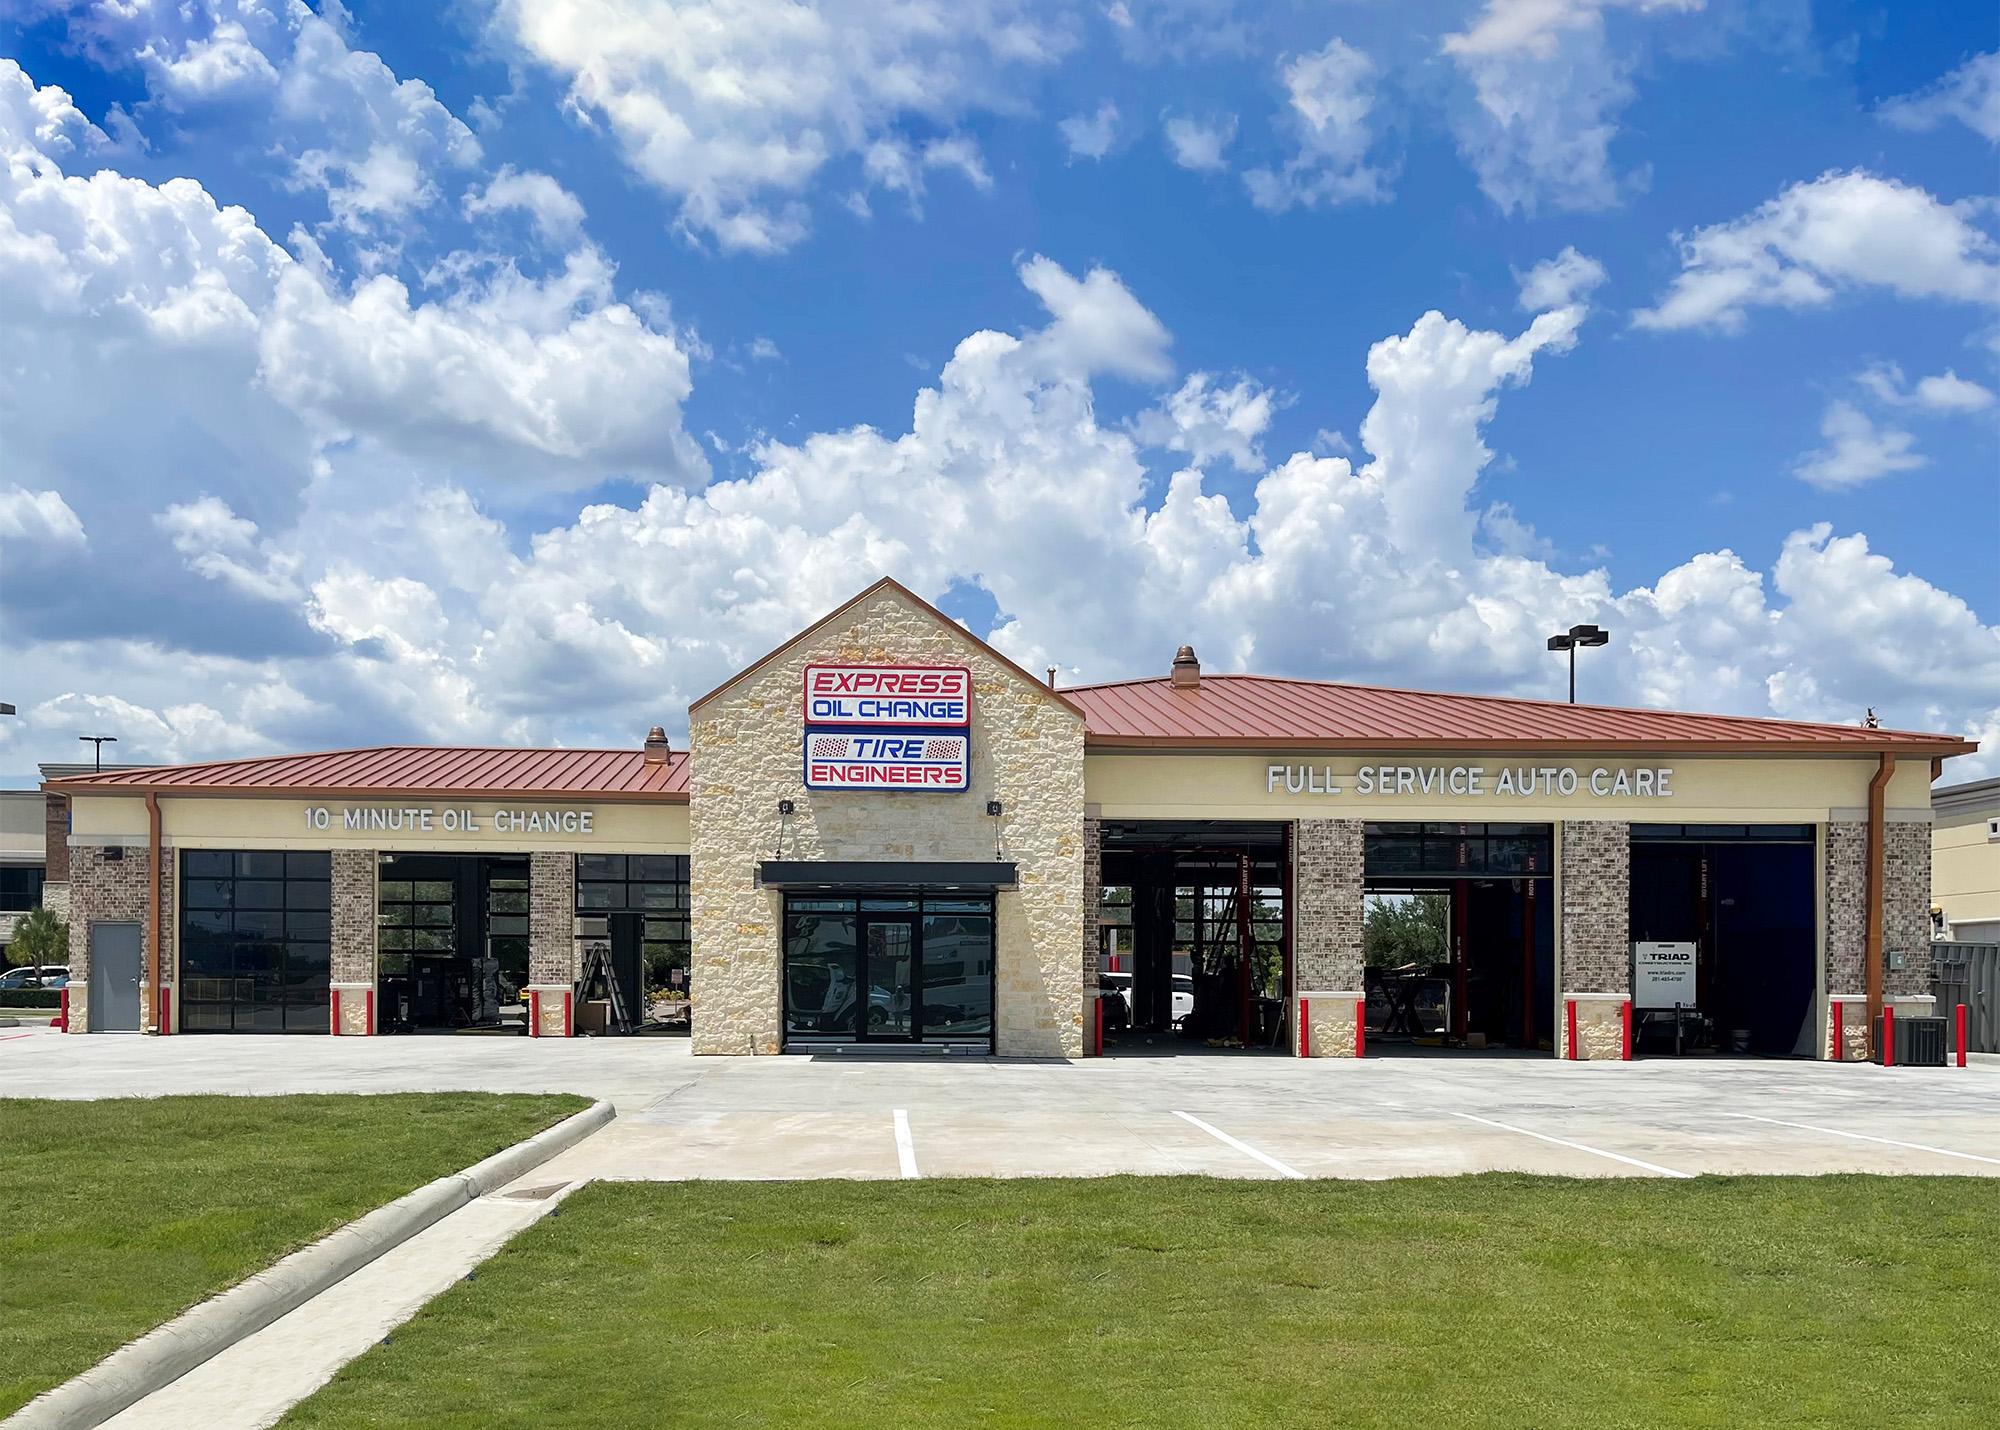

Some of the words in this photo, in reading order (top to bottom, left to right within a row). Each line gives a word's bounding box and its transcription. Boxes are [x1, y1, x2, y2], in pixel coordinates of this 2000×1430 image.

[813, 673, 963, 693] EXPRESS
[813, 700, 852, 716] OIL
[858, 701, 963, 718] CHANGE
[853, 739, 925, 758] TIRE
[812, 765, 962, 783] ENGINEERS
[1267, 765, 1342, 794] FULL
[1355, 766, 1484, 795] SERVICE
[1495, 767, 1577, 796] AUTO
[1589, 768, 1673, 797] CARE
[305, 807, 330, 830] 10
[343, 808, 433, 831] MINUTE
[442, 809, 479, 831] OIL
[494, 810, 593, 833] CHANGE
